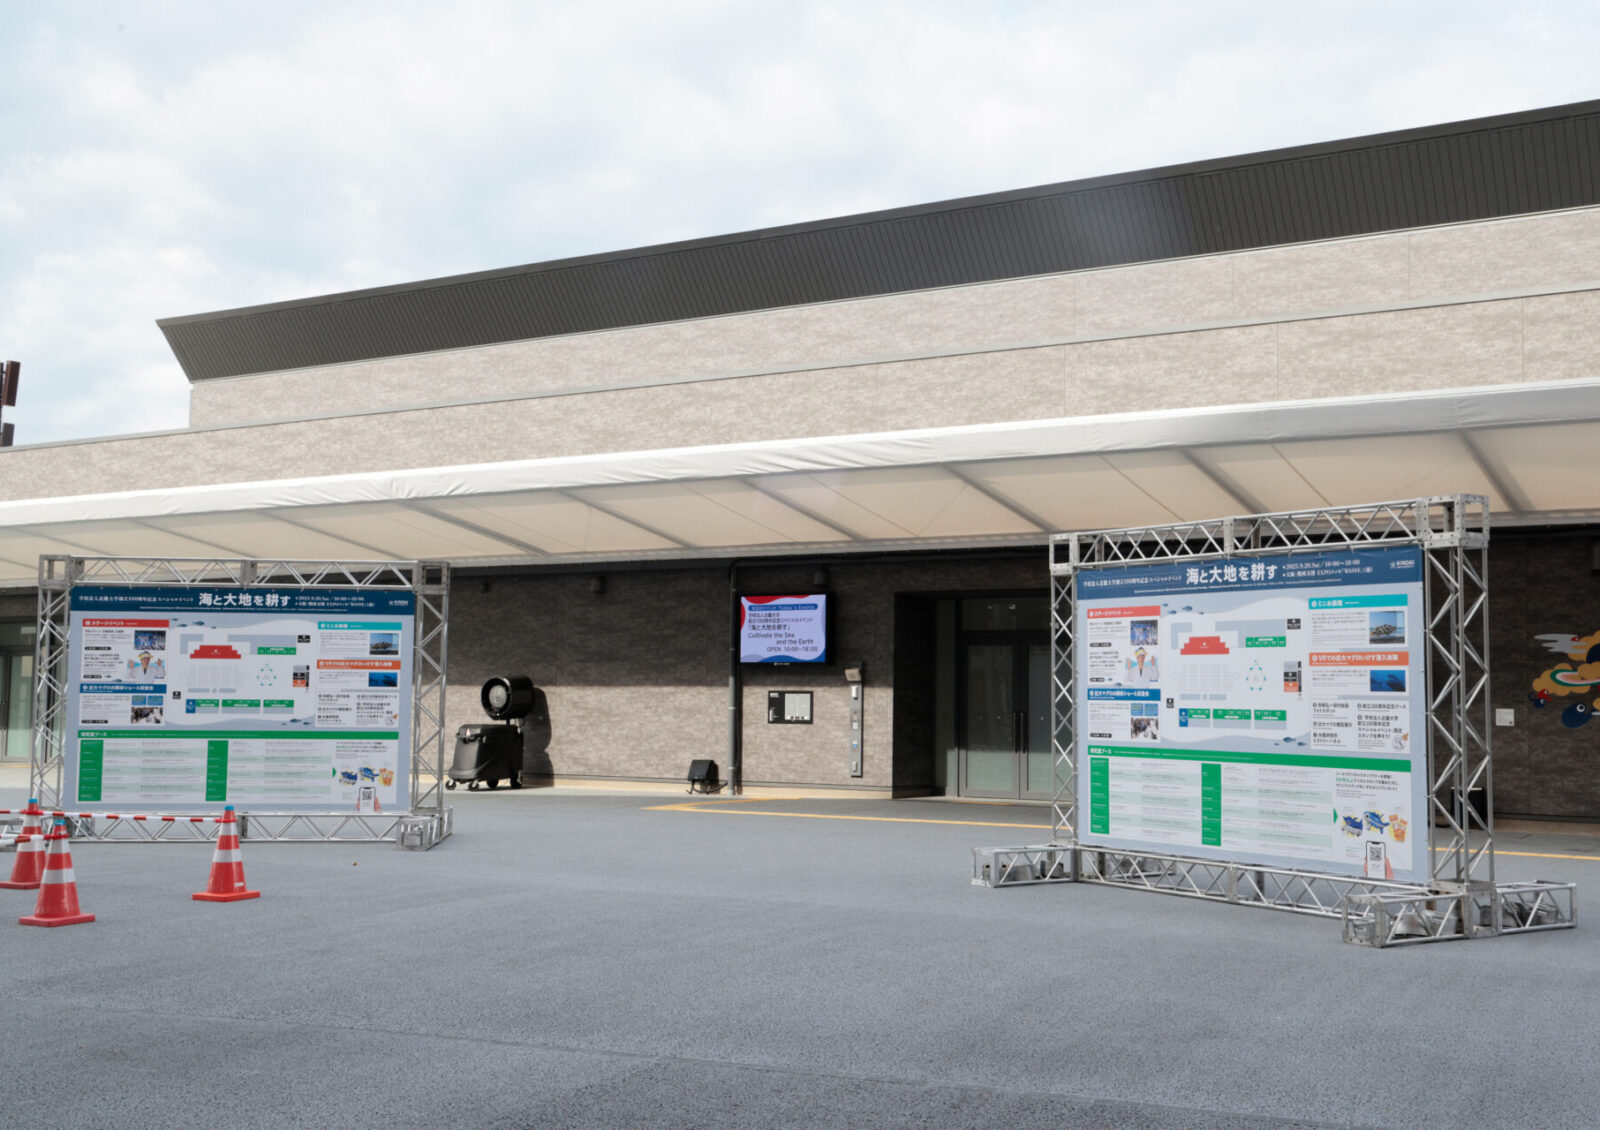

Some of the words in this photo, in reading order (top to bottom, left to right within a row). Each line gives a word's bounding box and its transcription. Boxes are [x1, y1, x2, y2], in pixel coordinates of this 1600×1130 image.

[1186, 562, 1278, 586] 海と大地を耕す
[198, 593, 291, 607] 海と大地を耕す
